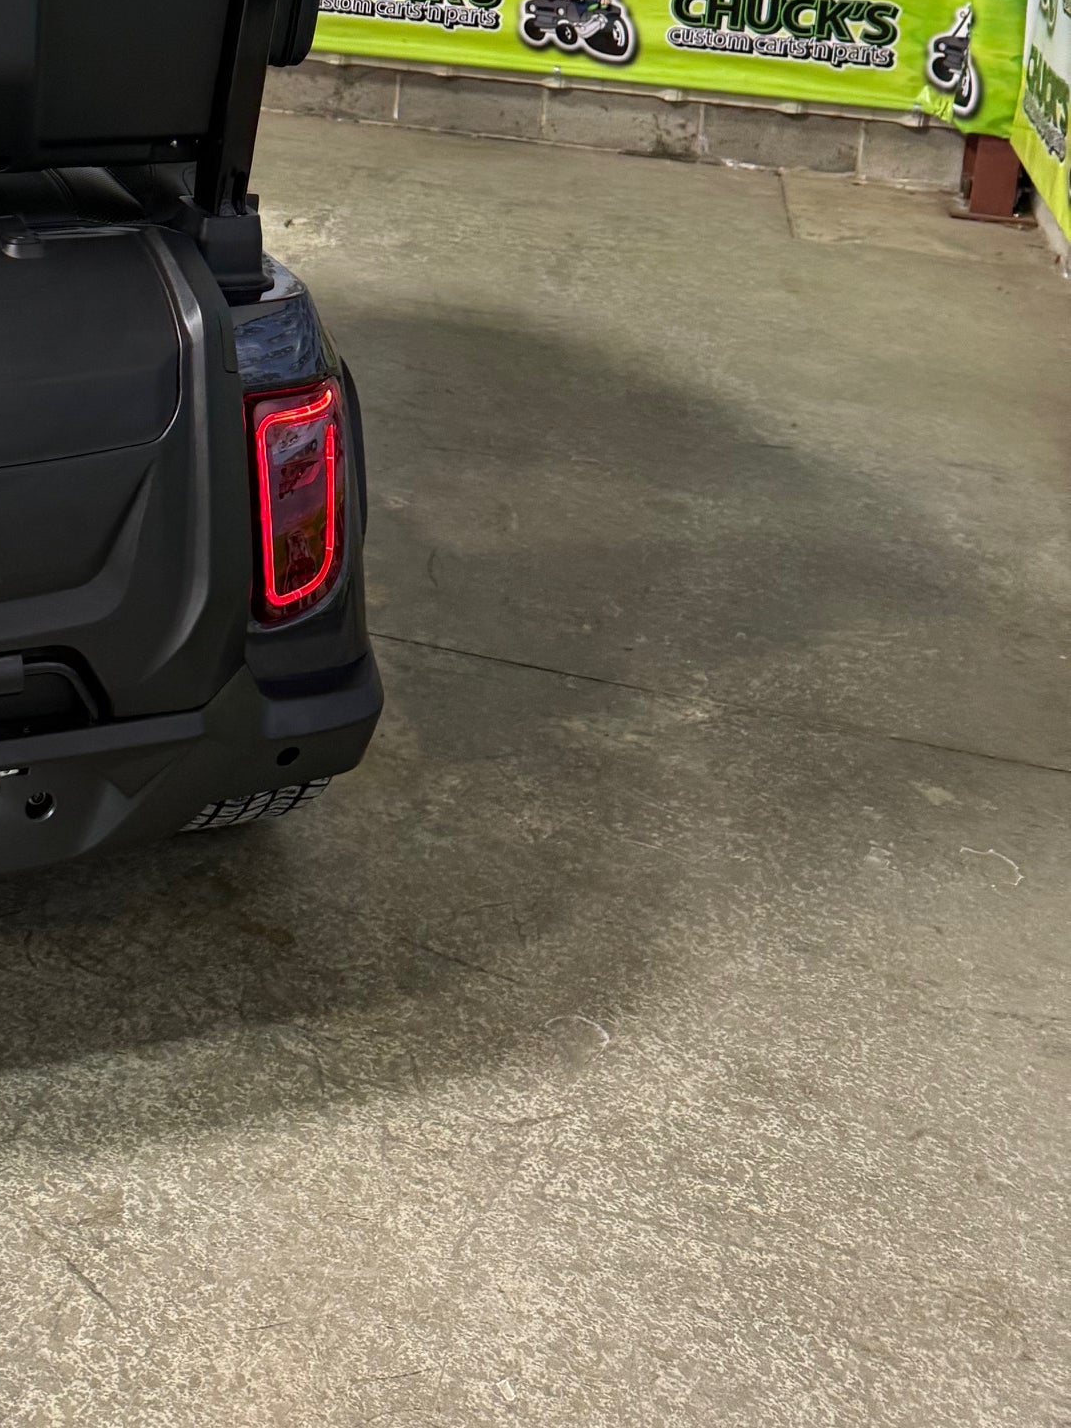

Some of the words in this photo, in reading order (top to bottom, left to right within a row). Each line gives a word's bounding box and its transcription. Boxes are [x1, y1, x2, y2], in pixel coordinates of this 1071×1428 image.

[444, 3, 501, 29] parts
[668, 27, 751, 52] custom
[832, 41, 893, 67] parts
